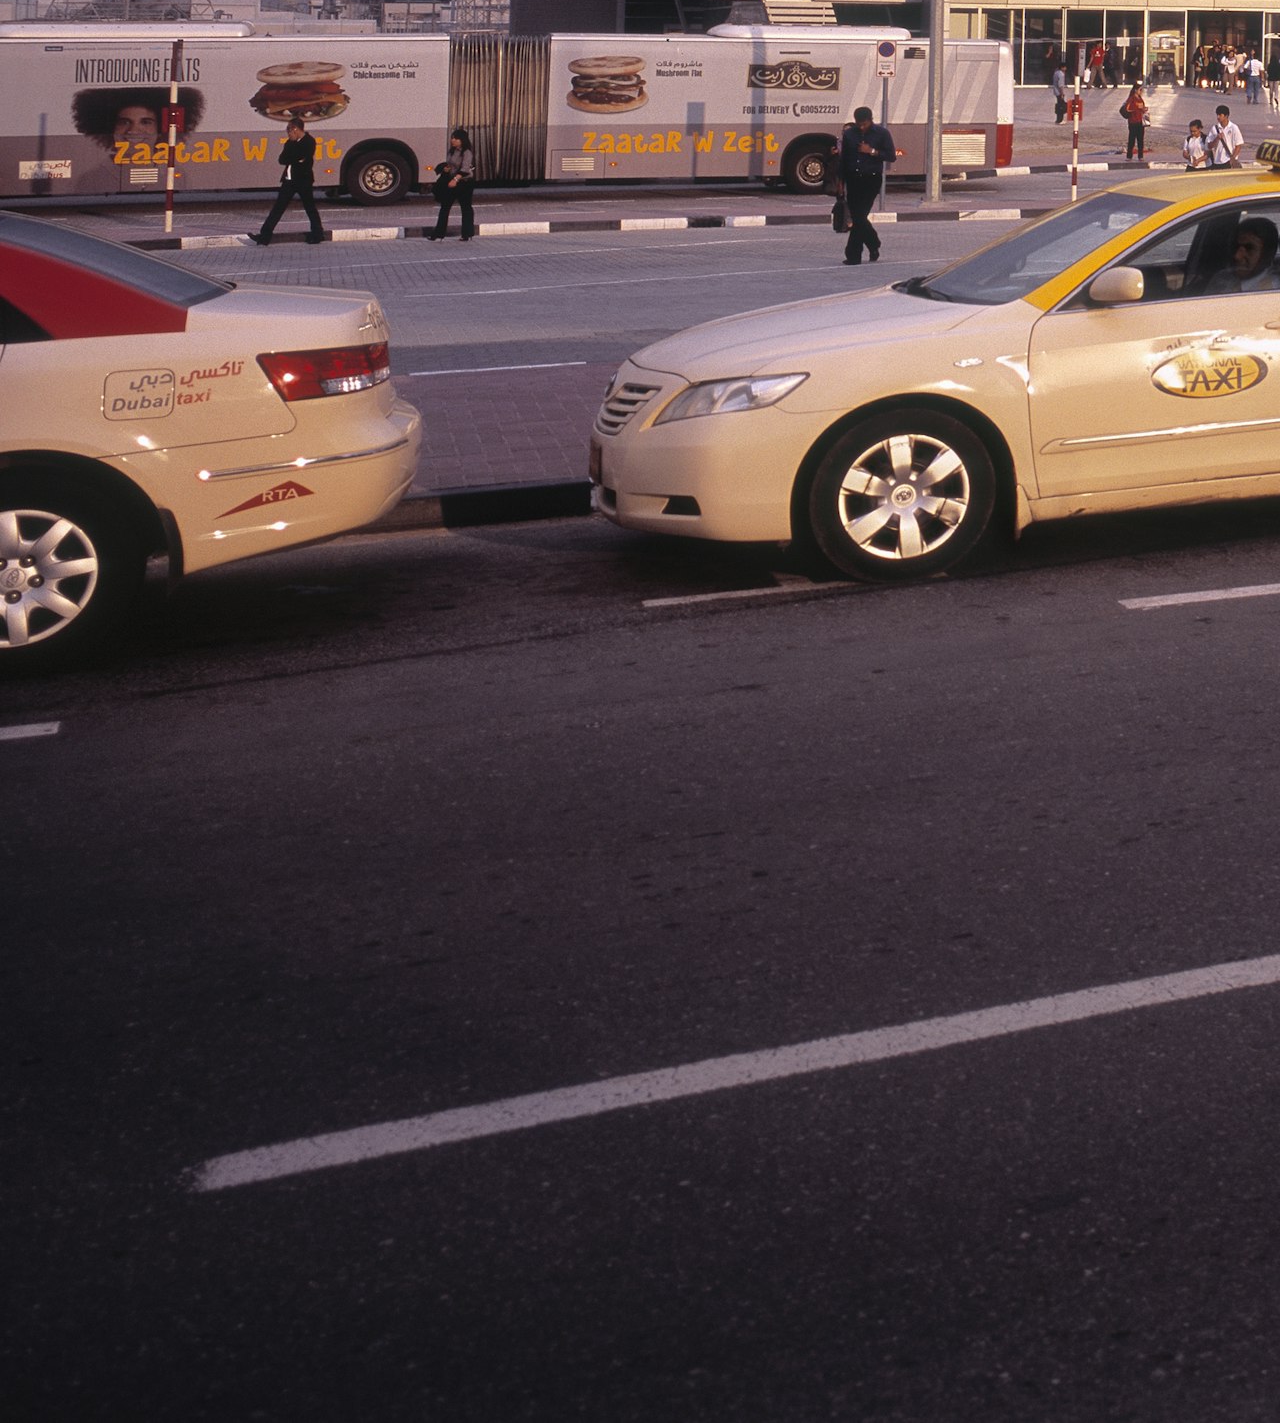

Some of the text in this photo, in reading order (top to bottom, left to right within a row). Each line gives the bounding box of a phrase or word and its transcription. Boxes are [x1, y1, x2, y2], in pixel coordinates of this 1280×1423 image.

[75, 58, 200, 83] INTRODUCING FTS
[353, 71, 400, 79] Chickensome
[742, 105, 840, 115] FOR DELIVERY 600522231
[243, 137, 268, 162] W
[694, 130, 714, 154] W
[722, 131, 780, 154] Zeit
[129, 361, 245, 393] تاكسي دبي
[1179, 368, 1242, 393] TAXI
[112, 388, 211, 412] Dubai taxi
[261, 488, 299, 502] RTA
